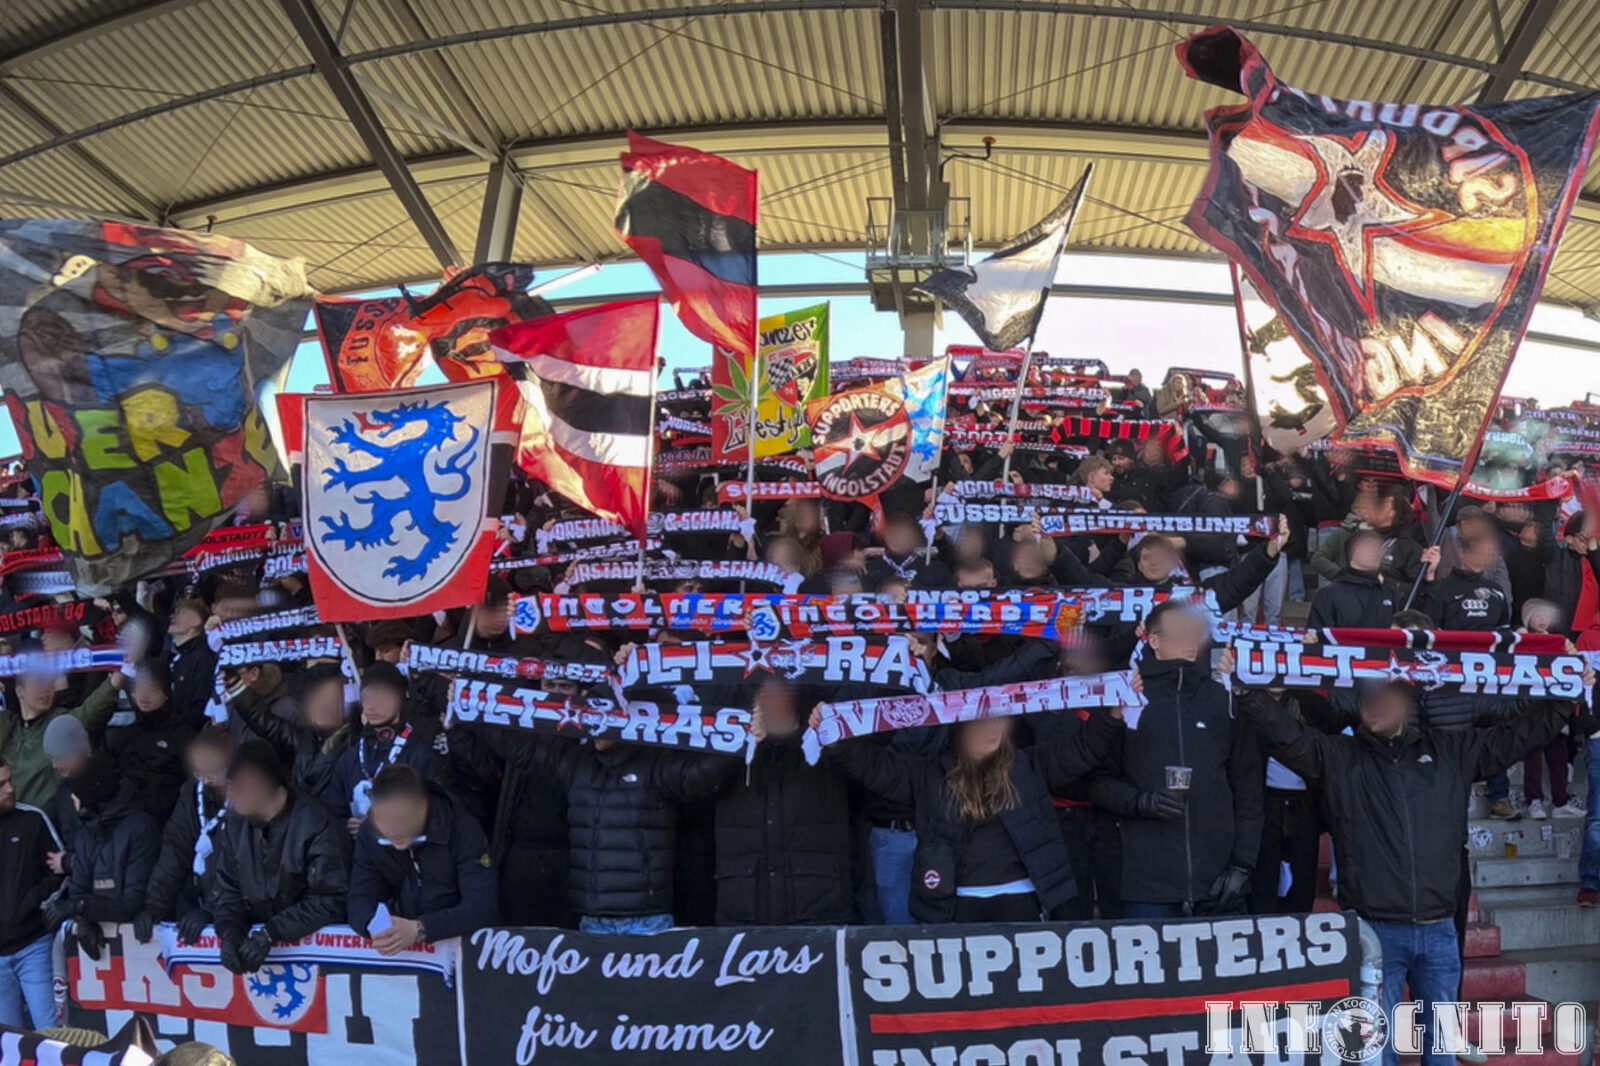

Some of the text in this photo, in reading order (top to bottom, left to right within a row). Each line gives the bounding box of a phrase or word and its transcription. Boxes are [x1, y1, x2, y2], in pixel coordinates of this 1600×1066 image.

[812, 392, 900, 445] SUPPORTERS
[822, 442, 907, 496] INGOLSTADT
[470, 928, 824, 994] Mofo und Lars
[861, 913, 1347, 1002] SUPPORTERS
[515, 1005, 775, 1066] für immer
